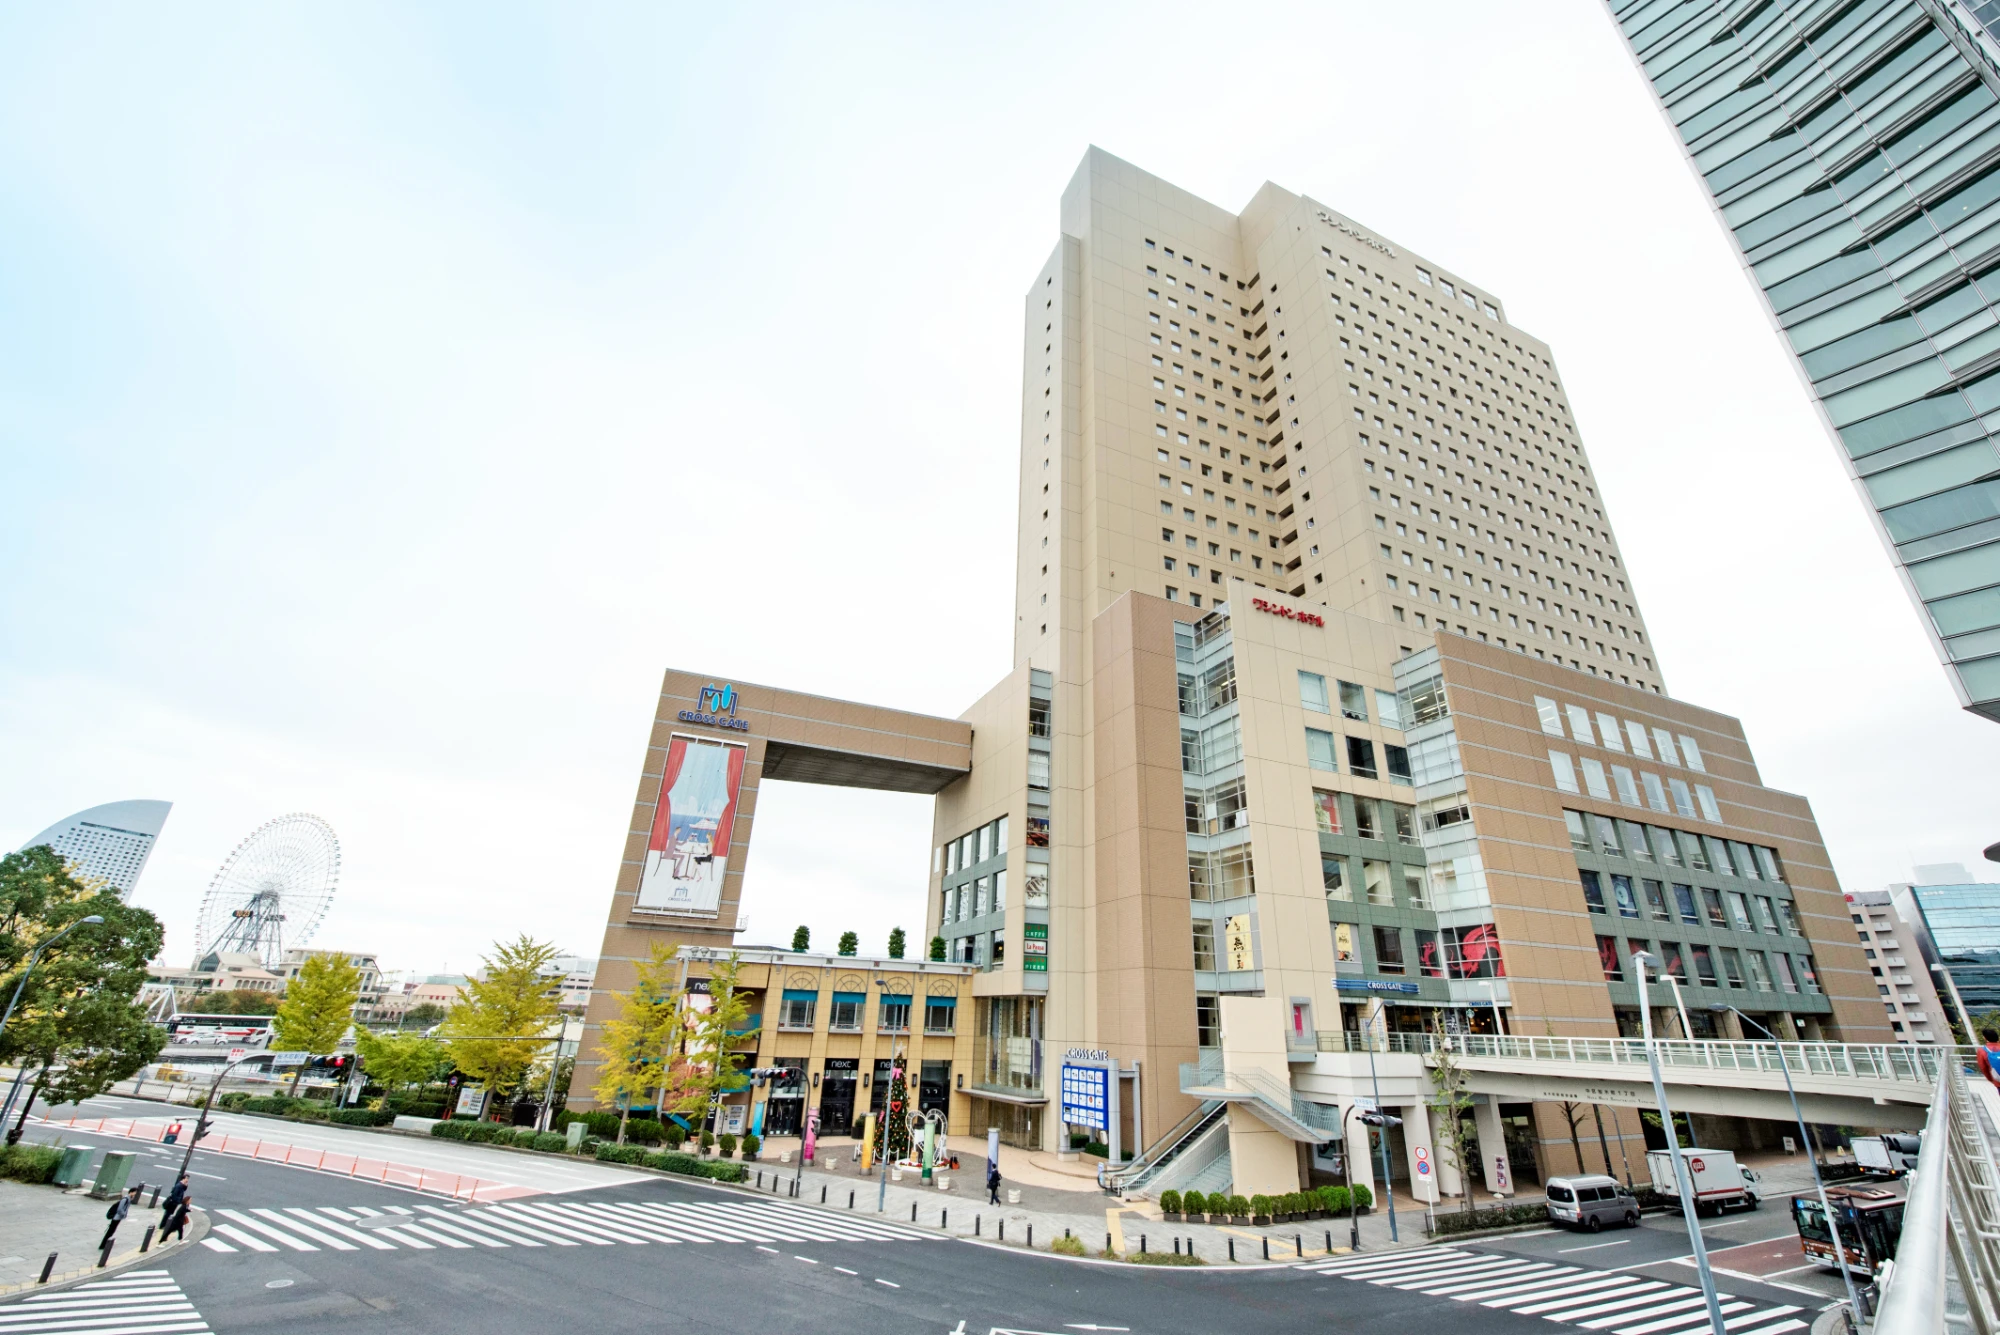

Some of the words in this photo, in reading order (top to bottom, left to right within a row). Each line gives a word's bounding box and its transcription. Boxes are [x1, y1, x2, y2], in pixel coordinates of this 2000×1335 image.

[1252, 597, 1325, 628] ワシントンホテル
[678, 710, 717, 725] CROSS
[718, 717, 749, 730] GATE
[1026, 942, 1032, 950] La
[1067, 1048, 1089, 1059] CROSS
[1089, 1049, 1109, 1061] GATE
[831, 1060, 852, 1068] next
